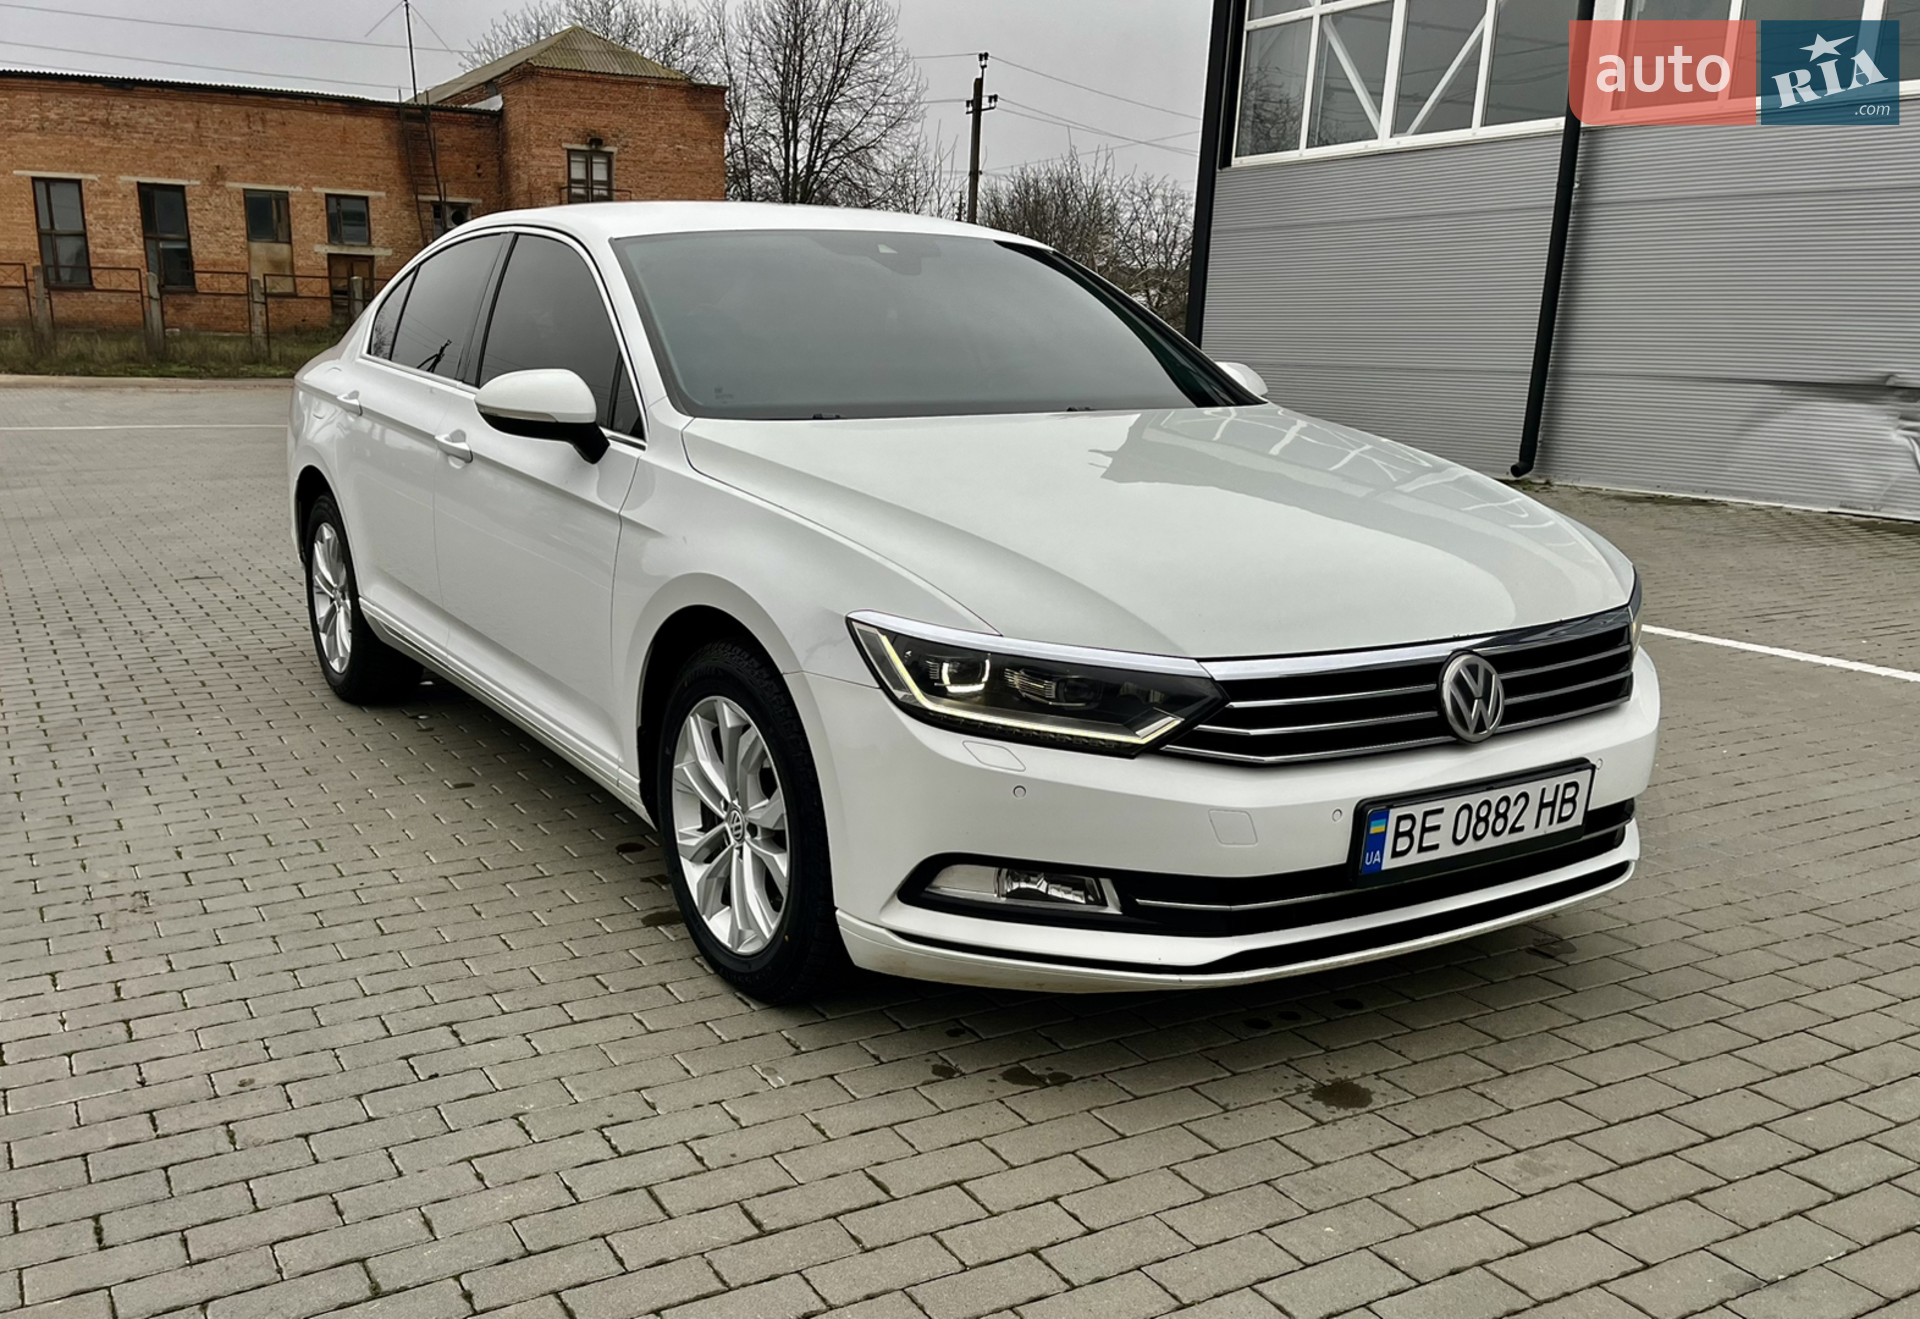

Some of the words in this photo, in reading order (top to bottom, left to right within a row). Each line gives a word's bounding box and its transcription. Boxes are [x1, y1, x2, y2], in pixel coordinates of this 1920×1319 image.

[1391, 807, 1444, 859] BE
[1452, 791, 1530, 845] 0882
[1534, 781, 1580, 829] HB
[1365, 851, 1381, 865] UA
